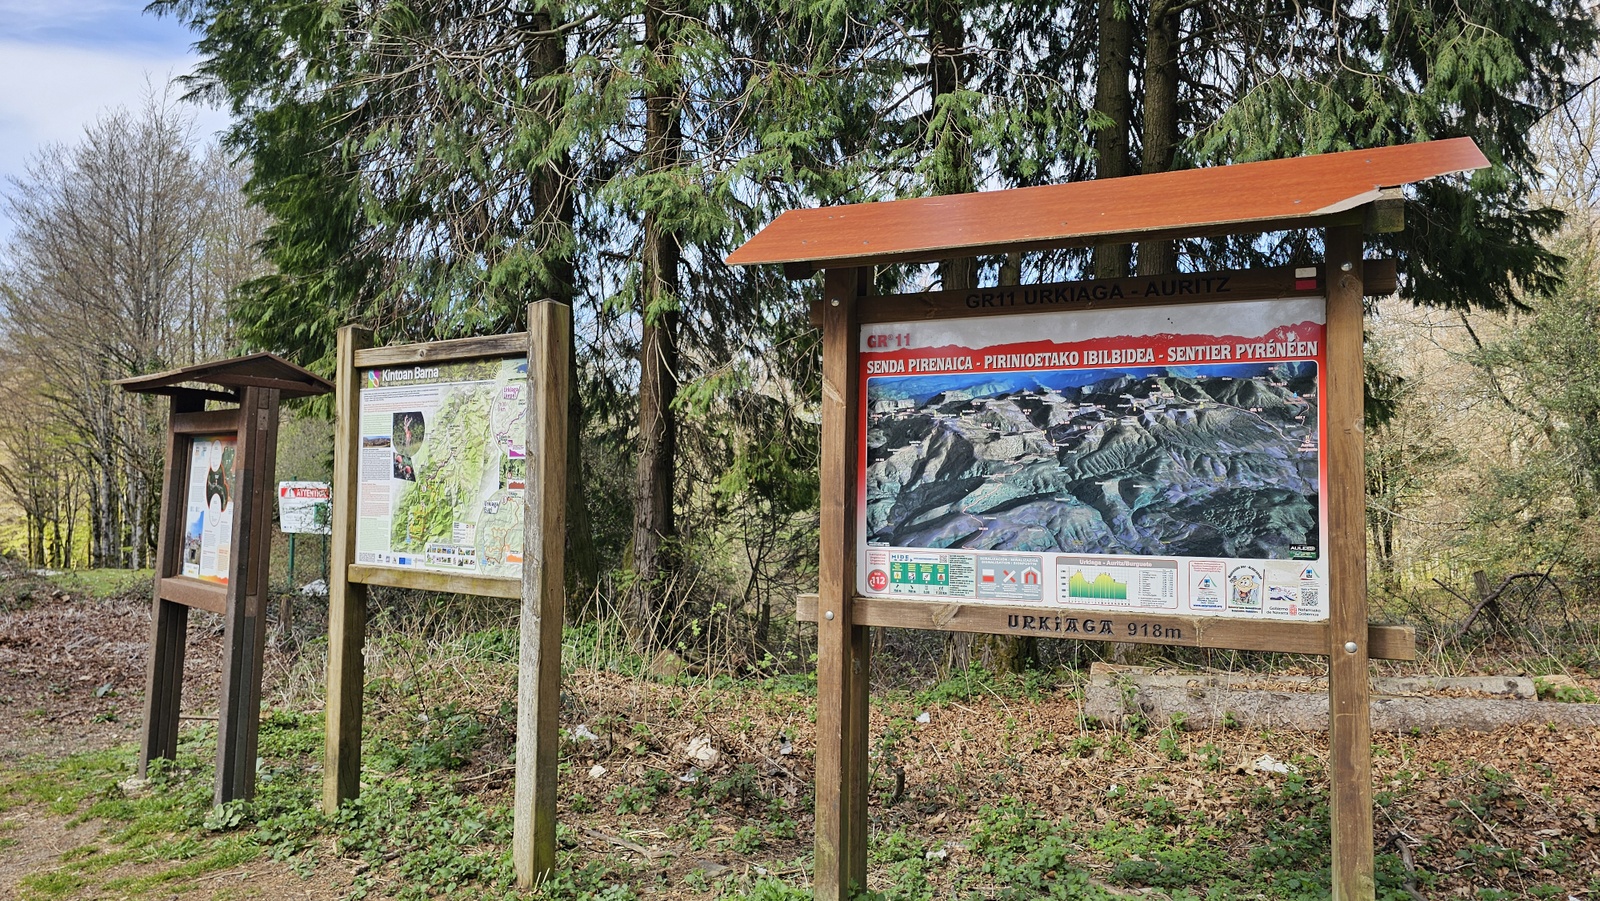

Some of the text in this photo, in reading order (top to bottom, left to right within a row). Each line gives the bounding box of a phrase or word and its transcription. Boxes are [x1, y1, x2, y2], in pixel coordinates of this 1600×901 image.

[1024, 283, 1124, 305] URKIAGA
[1144, 277, 1231, 297] AURITZ
[895, 333, 910, 346] 11
[866, 359, 905, 374] SENDA
[908, 356, 973, 372] PIRENAICA
[984, 351, 1080, 369] PIRINIOETAKO
[1083, 348, 1155, 366] IBILBIDEA
[1167, 344, 1232, 362] SENTIER
[1235, 338, 1319, 359] PYRÉNÉEN
[382, 366, 439, 382] Kintoan Barna
[872, 577, 886, 585] 112
[1127, 622, 1182, 640] 918m
